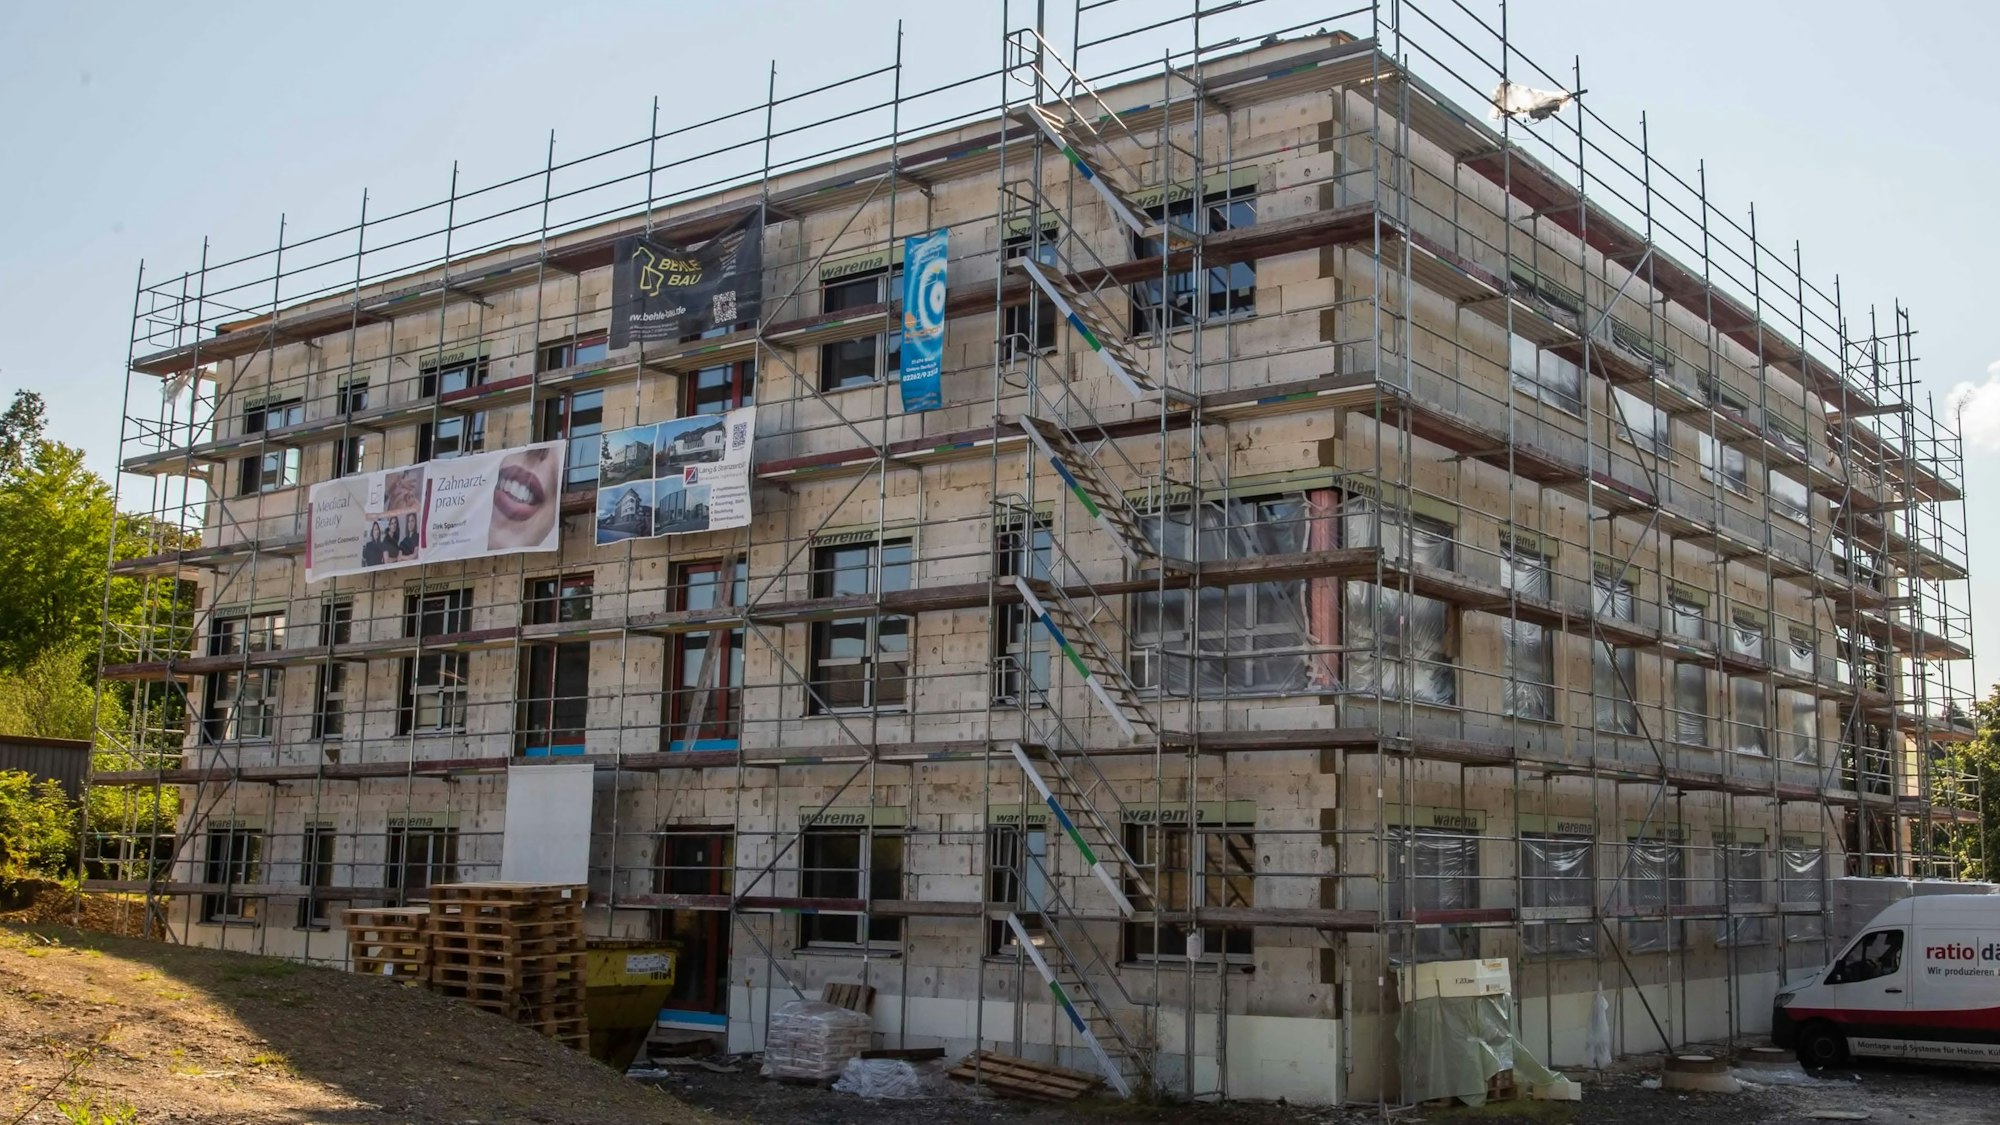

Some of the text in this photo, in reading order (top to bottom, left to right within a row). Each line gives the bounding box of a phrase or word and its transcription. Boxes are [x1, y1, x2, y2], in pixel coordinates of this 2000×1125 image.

[658, 258, 702, 272] BEHLE
[821, 255, 883, 279] warema
[668, 273, 702, 286] BAU
[1544, 281, 1579, 306] warema
[437, 475, 486, 491] Zahnarzt-
[316, 492, 351, 513] Medical
[435, 492, 465, 512] praxis
[315, 514, 343, 529] Beauty
[810, 530, 874, 546] warema
[801, 812, 865, 824] warema
[1557, 821, 1592, 833] warema
[1926, 943, 1974, 960] ratio
[1927, 966, 1994, 976] Wir produzieren
[1857, 1041, 1891, 1051] Montage
[1893, 1043, 1907, 1051] und
[1910, 1044, 1941, 1053] Systeme
